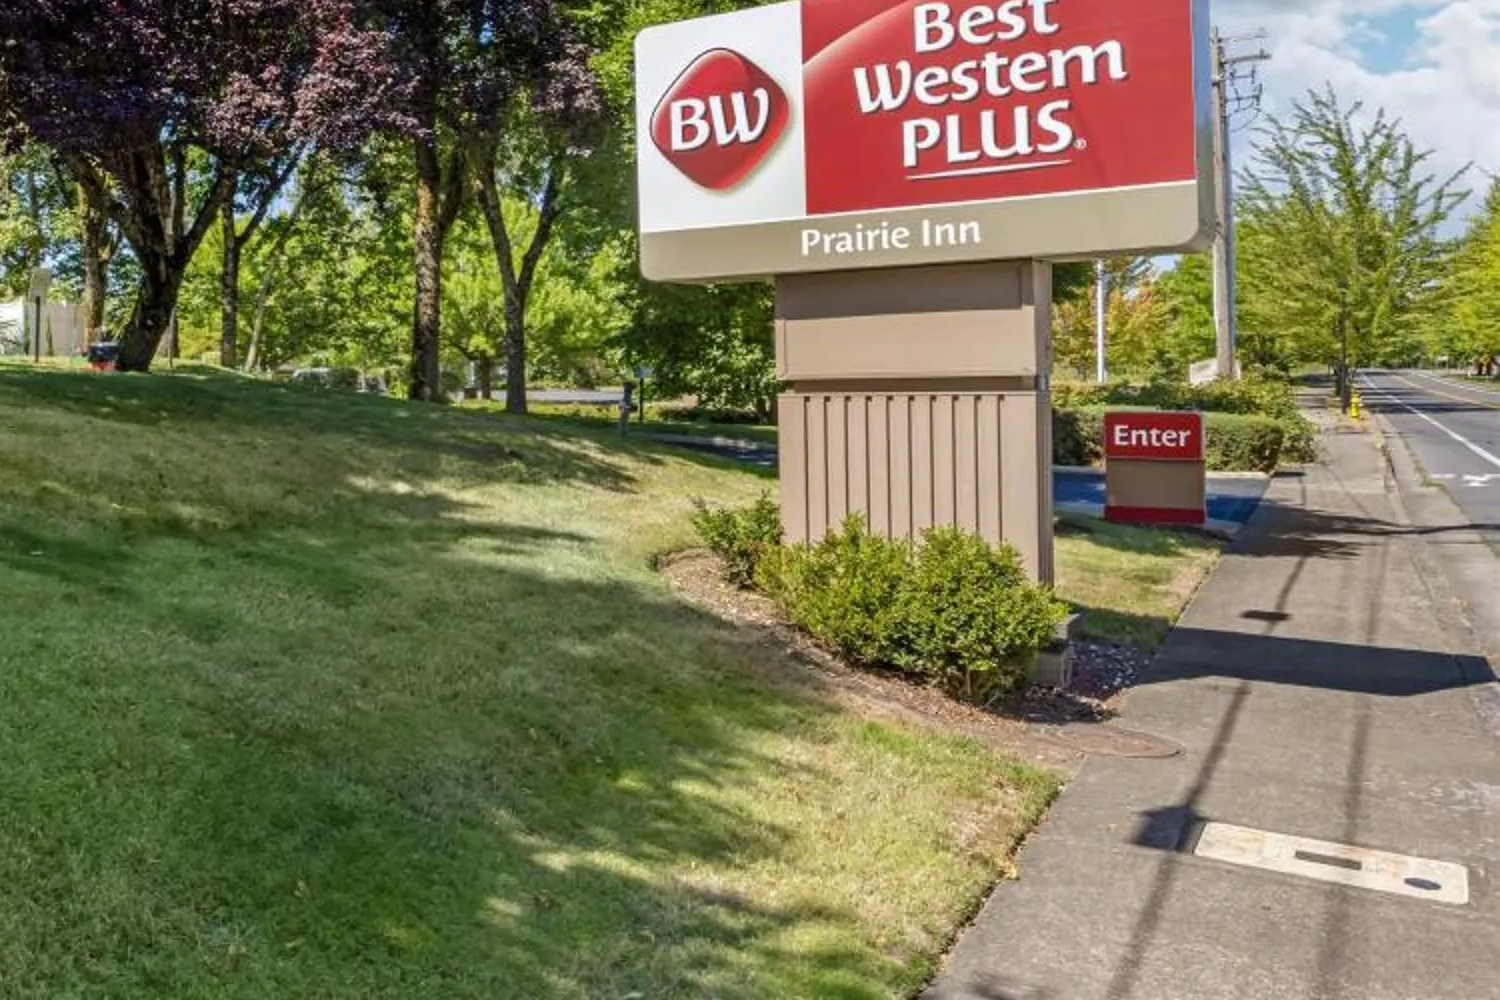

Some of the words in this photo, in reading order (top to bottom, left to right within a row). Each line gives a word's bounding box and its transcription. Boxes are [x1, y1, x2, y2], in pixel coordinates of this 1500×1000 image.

[853, 40, 1127, 113] Western
[669, 87, 769, 151] BW
[902, 100, 1073, 167] PLUS
[801, 227, 909, 256] Prairie
[922, 219, 981, 247] Inn
[1113, 424, 1191, 447] Enter
